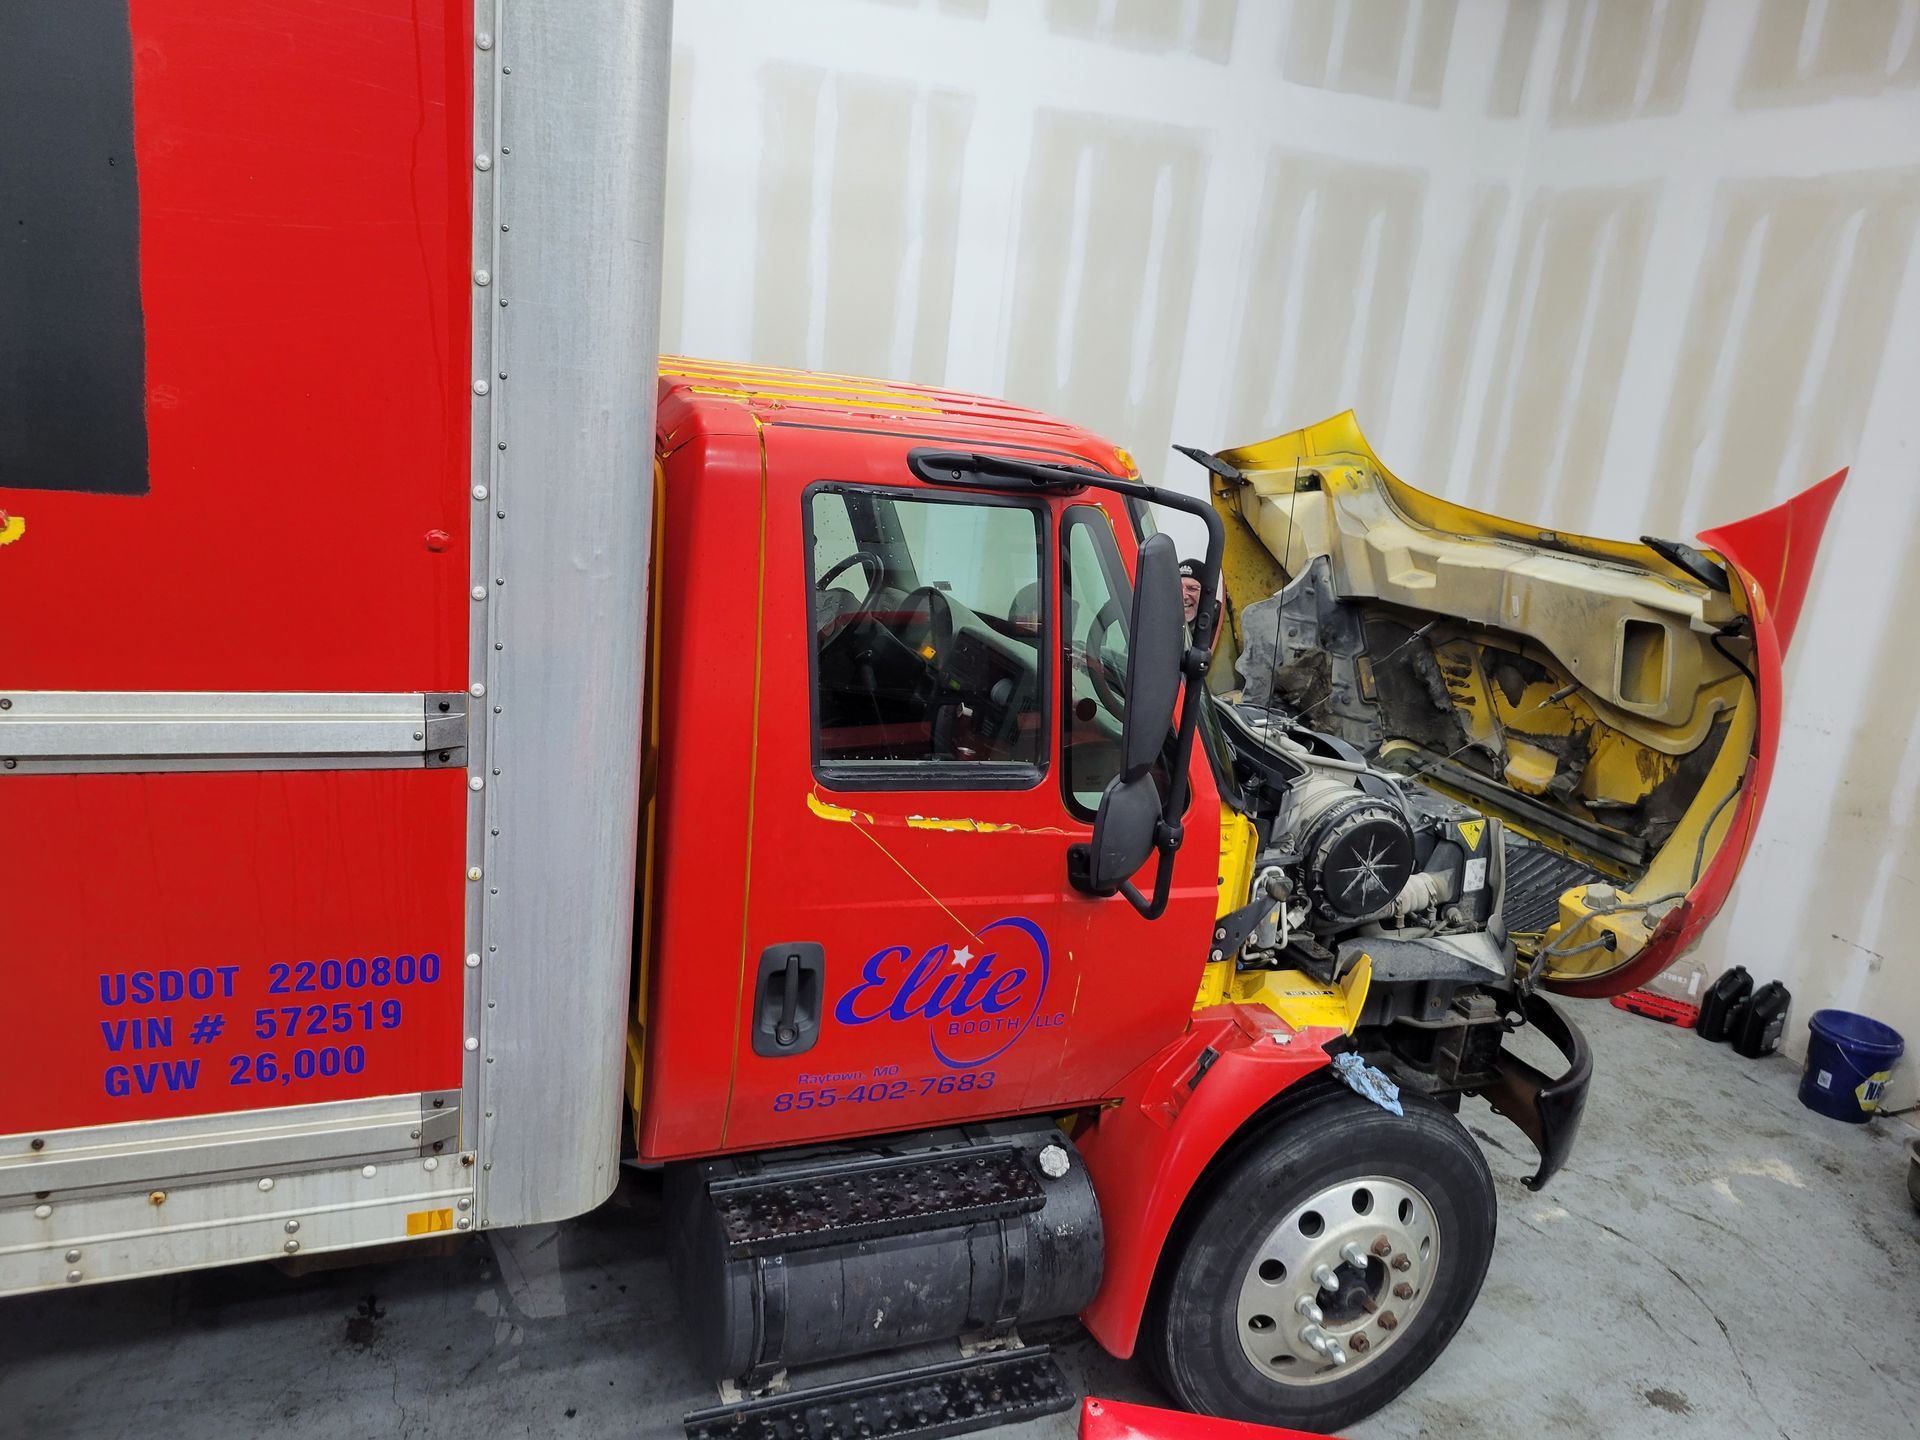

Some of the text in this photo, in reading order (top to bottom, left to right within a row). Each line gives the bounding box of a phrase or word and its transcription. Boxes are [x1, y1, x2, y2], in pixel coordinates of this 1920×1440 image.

[99, 952, 441, 1007] USDOT 2200800
[834, 943, 1028, 1025] Elite
[100, 999, 403, 1052] VIN # 572519
[948, 1013, 1065, 1036] BOOTH LLC
[104, 1044, 365, 1097] GVW 26,000
[772, 1070, 996, 1113] 855-402-7683
[874, 1064, 900, 1078] MO
